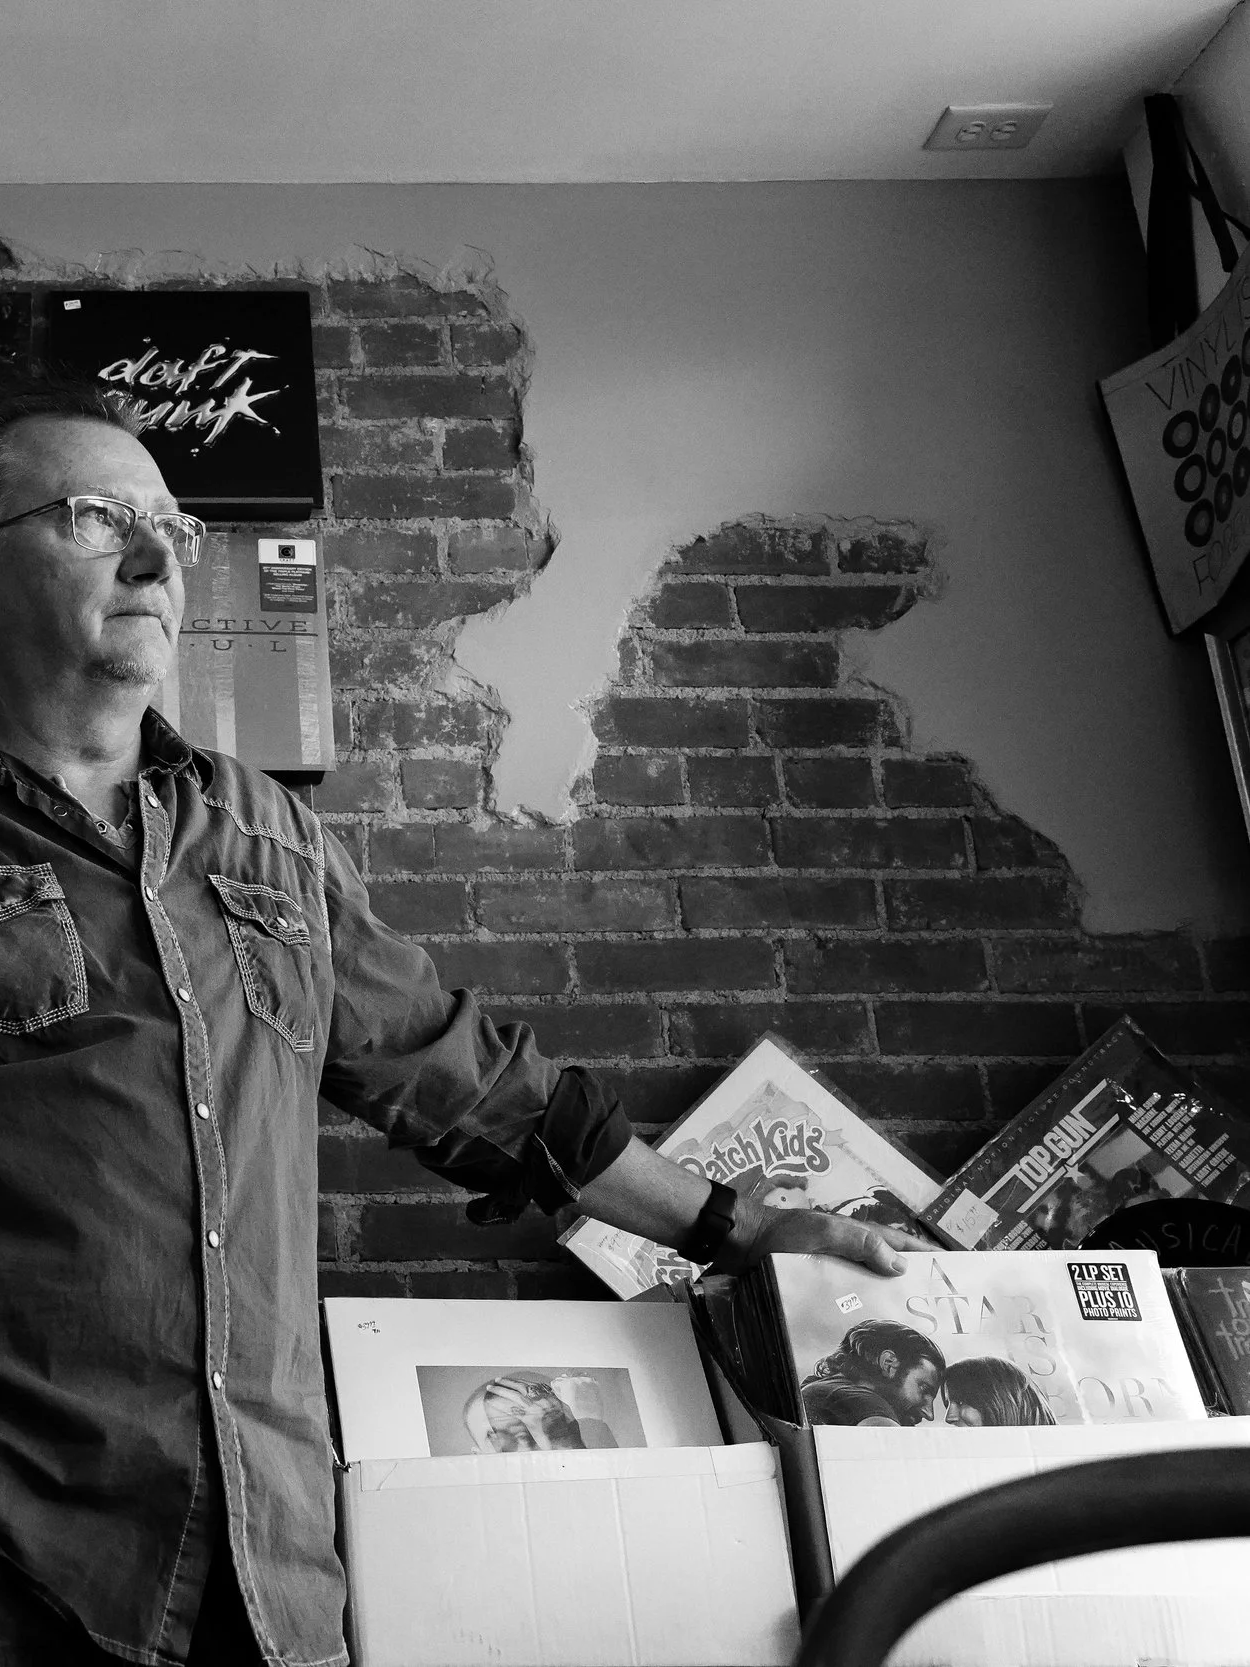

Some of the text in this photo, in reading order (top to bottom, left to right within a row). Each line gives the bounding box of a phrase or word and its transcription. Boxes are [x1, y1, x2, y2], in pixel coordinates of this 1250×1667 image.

[179, 618, 307, 633] CTIVE
[756, 1118, 833, 1176] Kids
[998, 1094, 1102, 1196] TOP GUN
[1108, 1222, 1243, 1258] USICA
[1071, 1264, 1124, 1281] 2 LP SET
[1078, 1290, 1134, 1309] PLUS 10
[1083, 1307, 1138, 1318] PHOTO PRINTS
